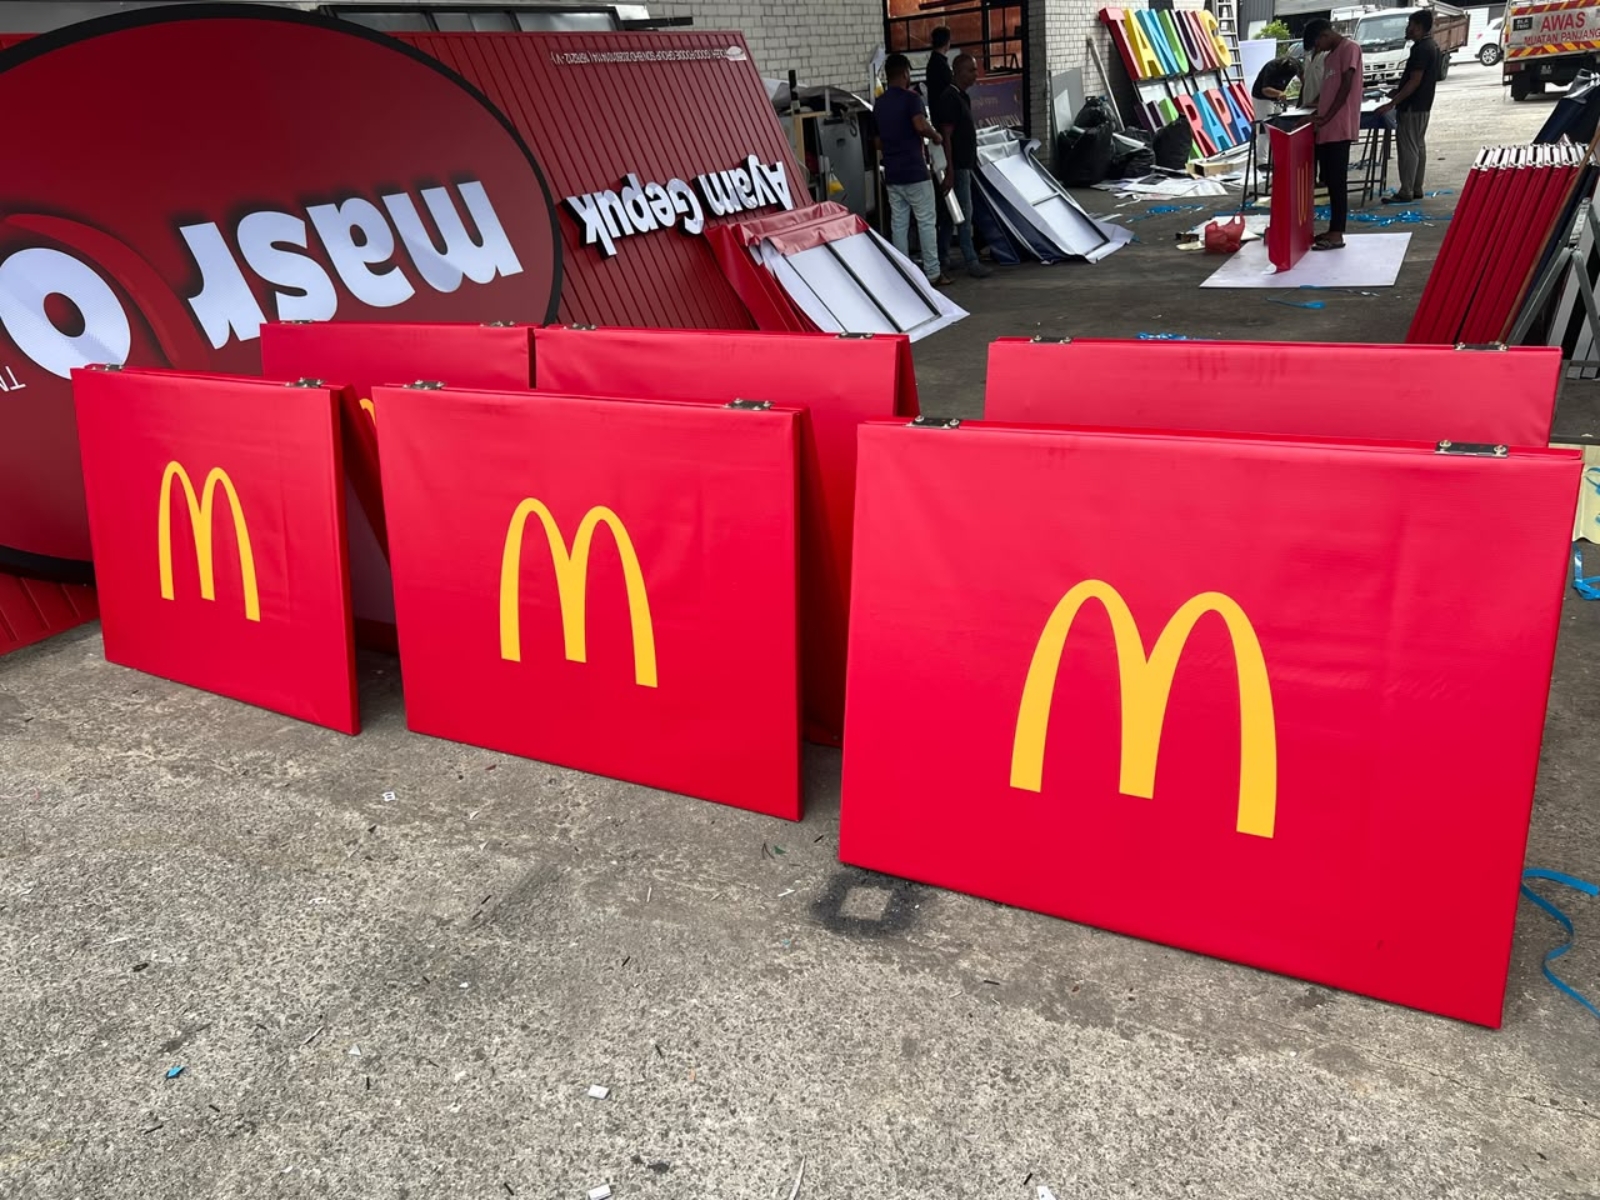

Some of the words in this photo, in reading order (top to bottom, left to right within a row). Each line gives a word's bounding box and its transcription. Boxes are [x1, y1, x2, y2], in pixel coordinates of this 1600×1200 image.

[1524, 33, 1558, 46] MUATAN
[1540, 11, 1586, 33] AWAS
[697, 154, 793, 216] Ayam
[560, 173, 704, 256] Gepuk
